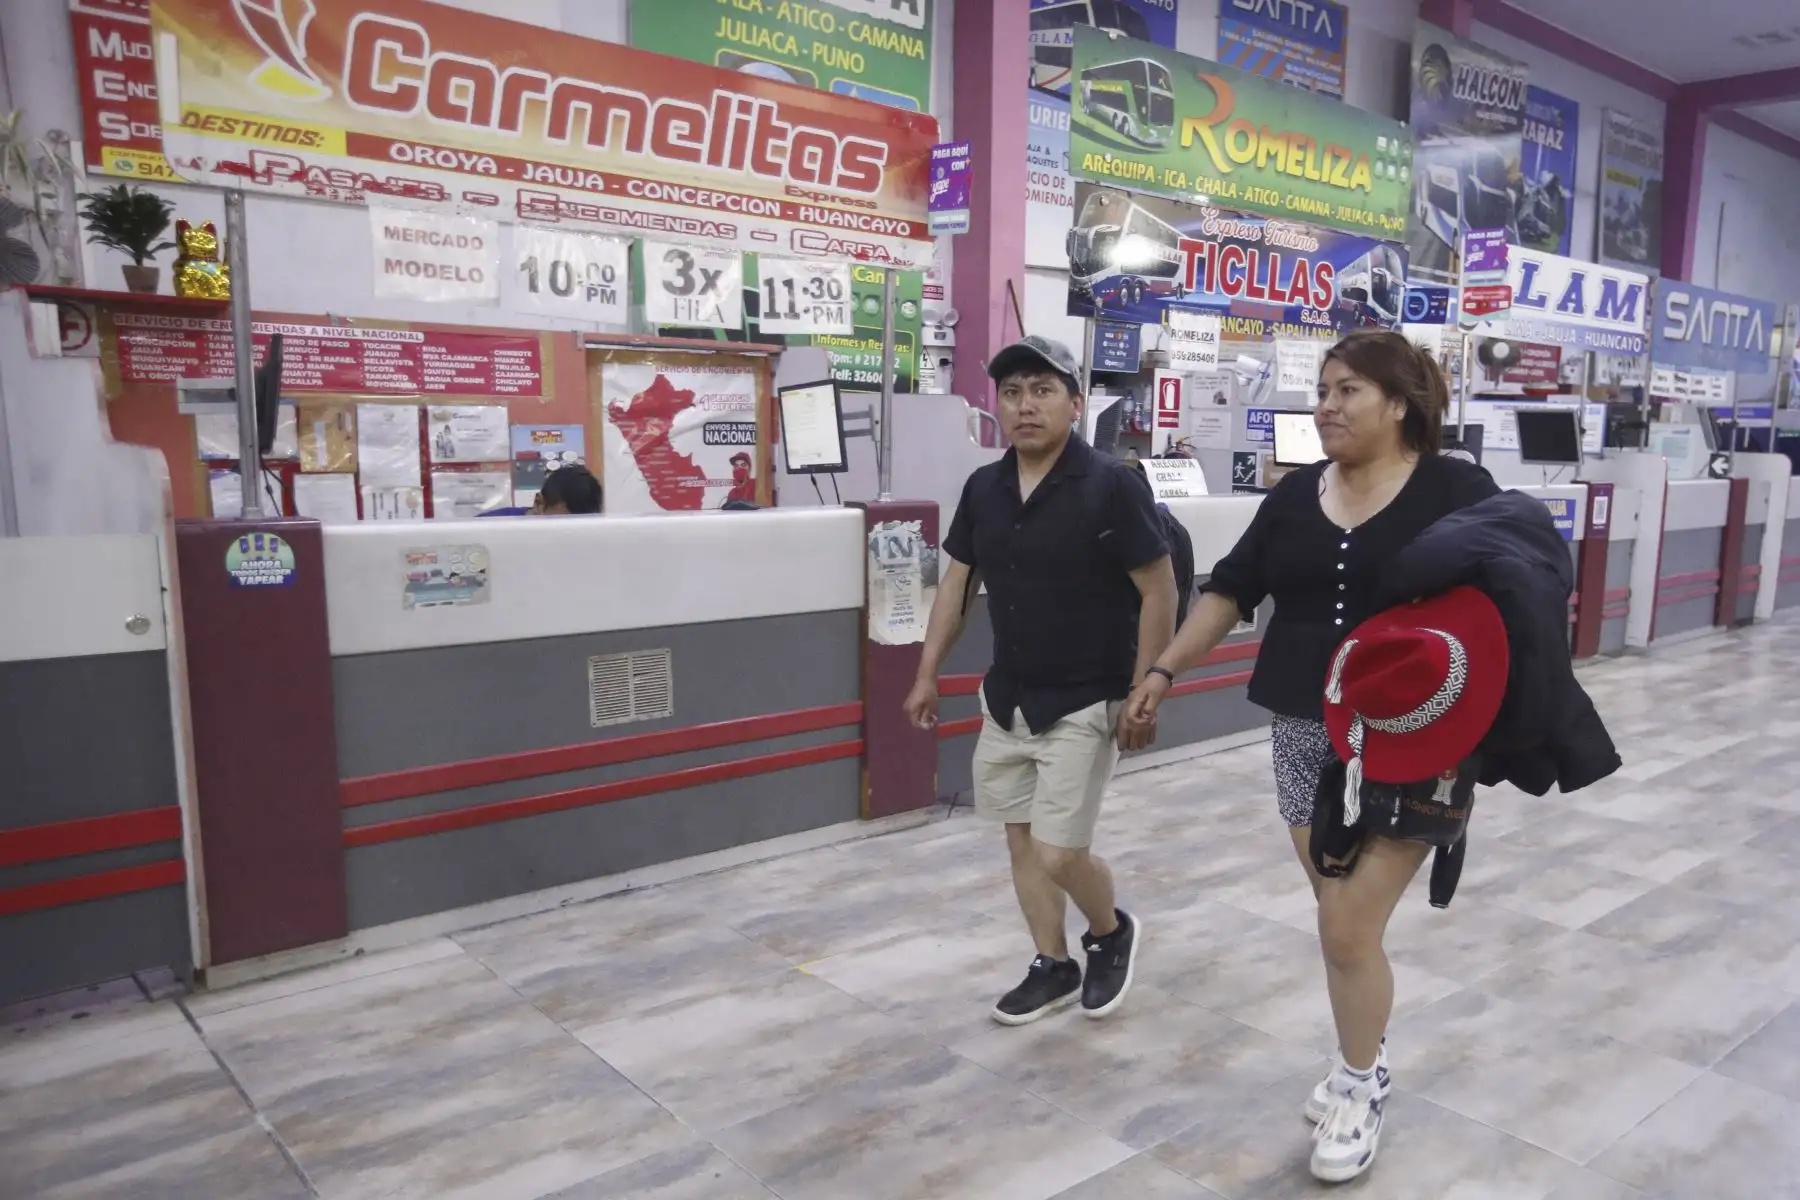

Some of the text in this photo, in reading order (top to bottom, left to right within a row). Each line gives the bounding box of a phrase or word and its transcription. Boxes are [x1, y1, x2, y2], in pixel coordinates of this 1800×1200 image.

[777, 1, 835, 34] ATICO
[848, 20, 925, 60] CAMANA
[715, 16, 865, 73] JULIACA PUNO
[342, 11, 889, 195] Carmelitas
[179, 111, 326, 148] DESTINOS:
[1180, 73, 1373, 193] ROMELIZA
[389, 142, 498, 175] OROYA
[522, 163, 605, 191] JAUJA
[799, 206, 911, 237] HUANCAYO
[1052, 175, 1066, 190] DE
[1081, 152, 1404, 232] AREQUIPA ICA CHALA ATICO CAMANA JULIACA PUNO
[784, 184, 878, 210] Express
[384, 224, 484, 251] MERCADO
[1201, 207, 1320, 253] Expreso Turismo
[384, 257, 485, 284] MODELO
[1178, 237, 1336, 311] TICLLAS
[586, 286, 617, 306] PM
[114, 315, 183, 328] SERVICIO
[188, 319, 206, 329] DE
[310, 327, 319, 336] A
[322, 327, 358, 338] NIVEL
[362, 329, 422, 341] NACIONAL
[812, 306, 844, 325] PM
[818, 334, 858, 348] Informes
[860, 340, 866, 351] y
[1585, 330, 1642, 352] HUANCAYO
[705, 430, 757, 443] NACIONAL
